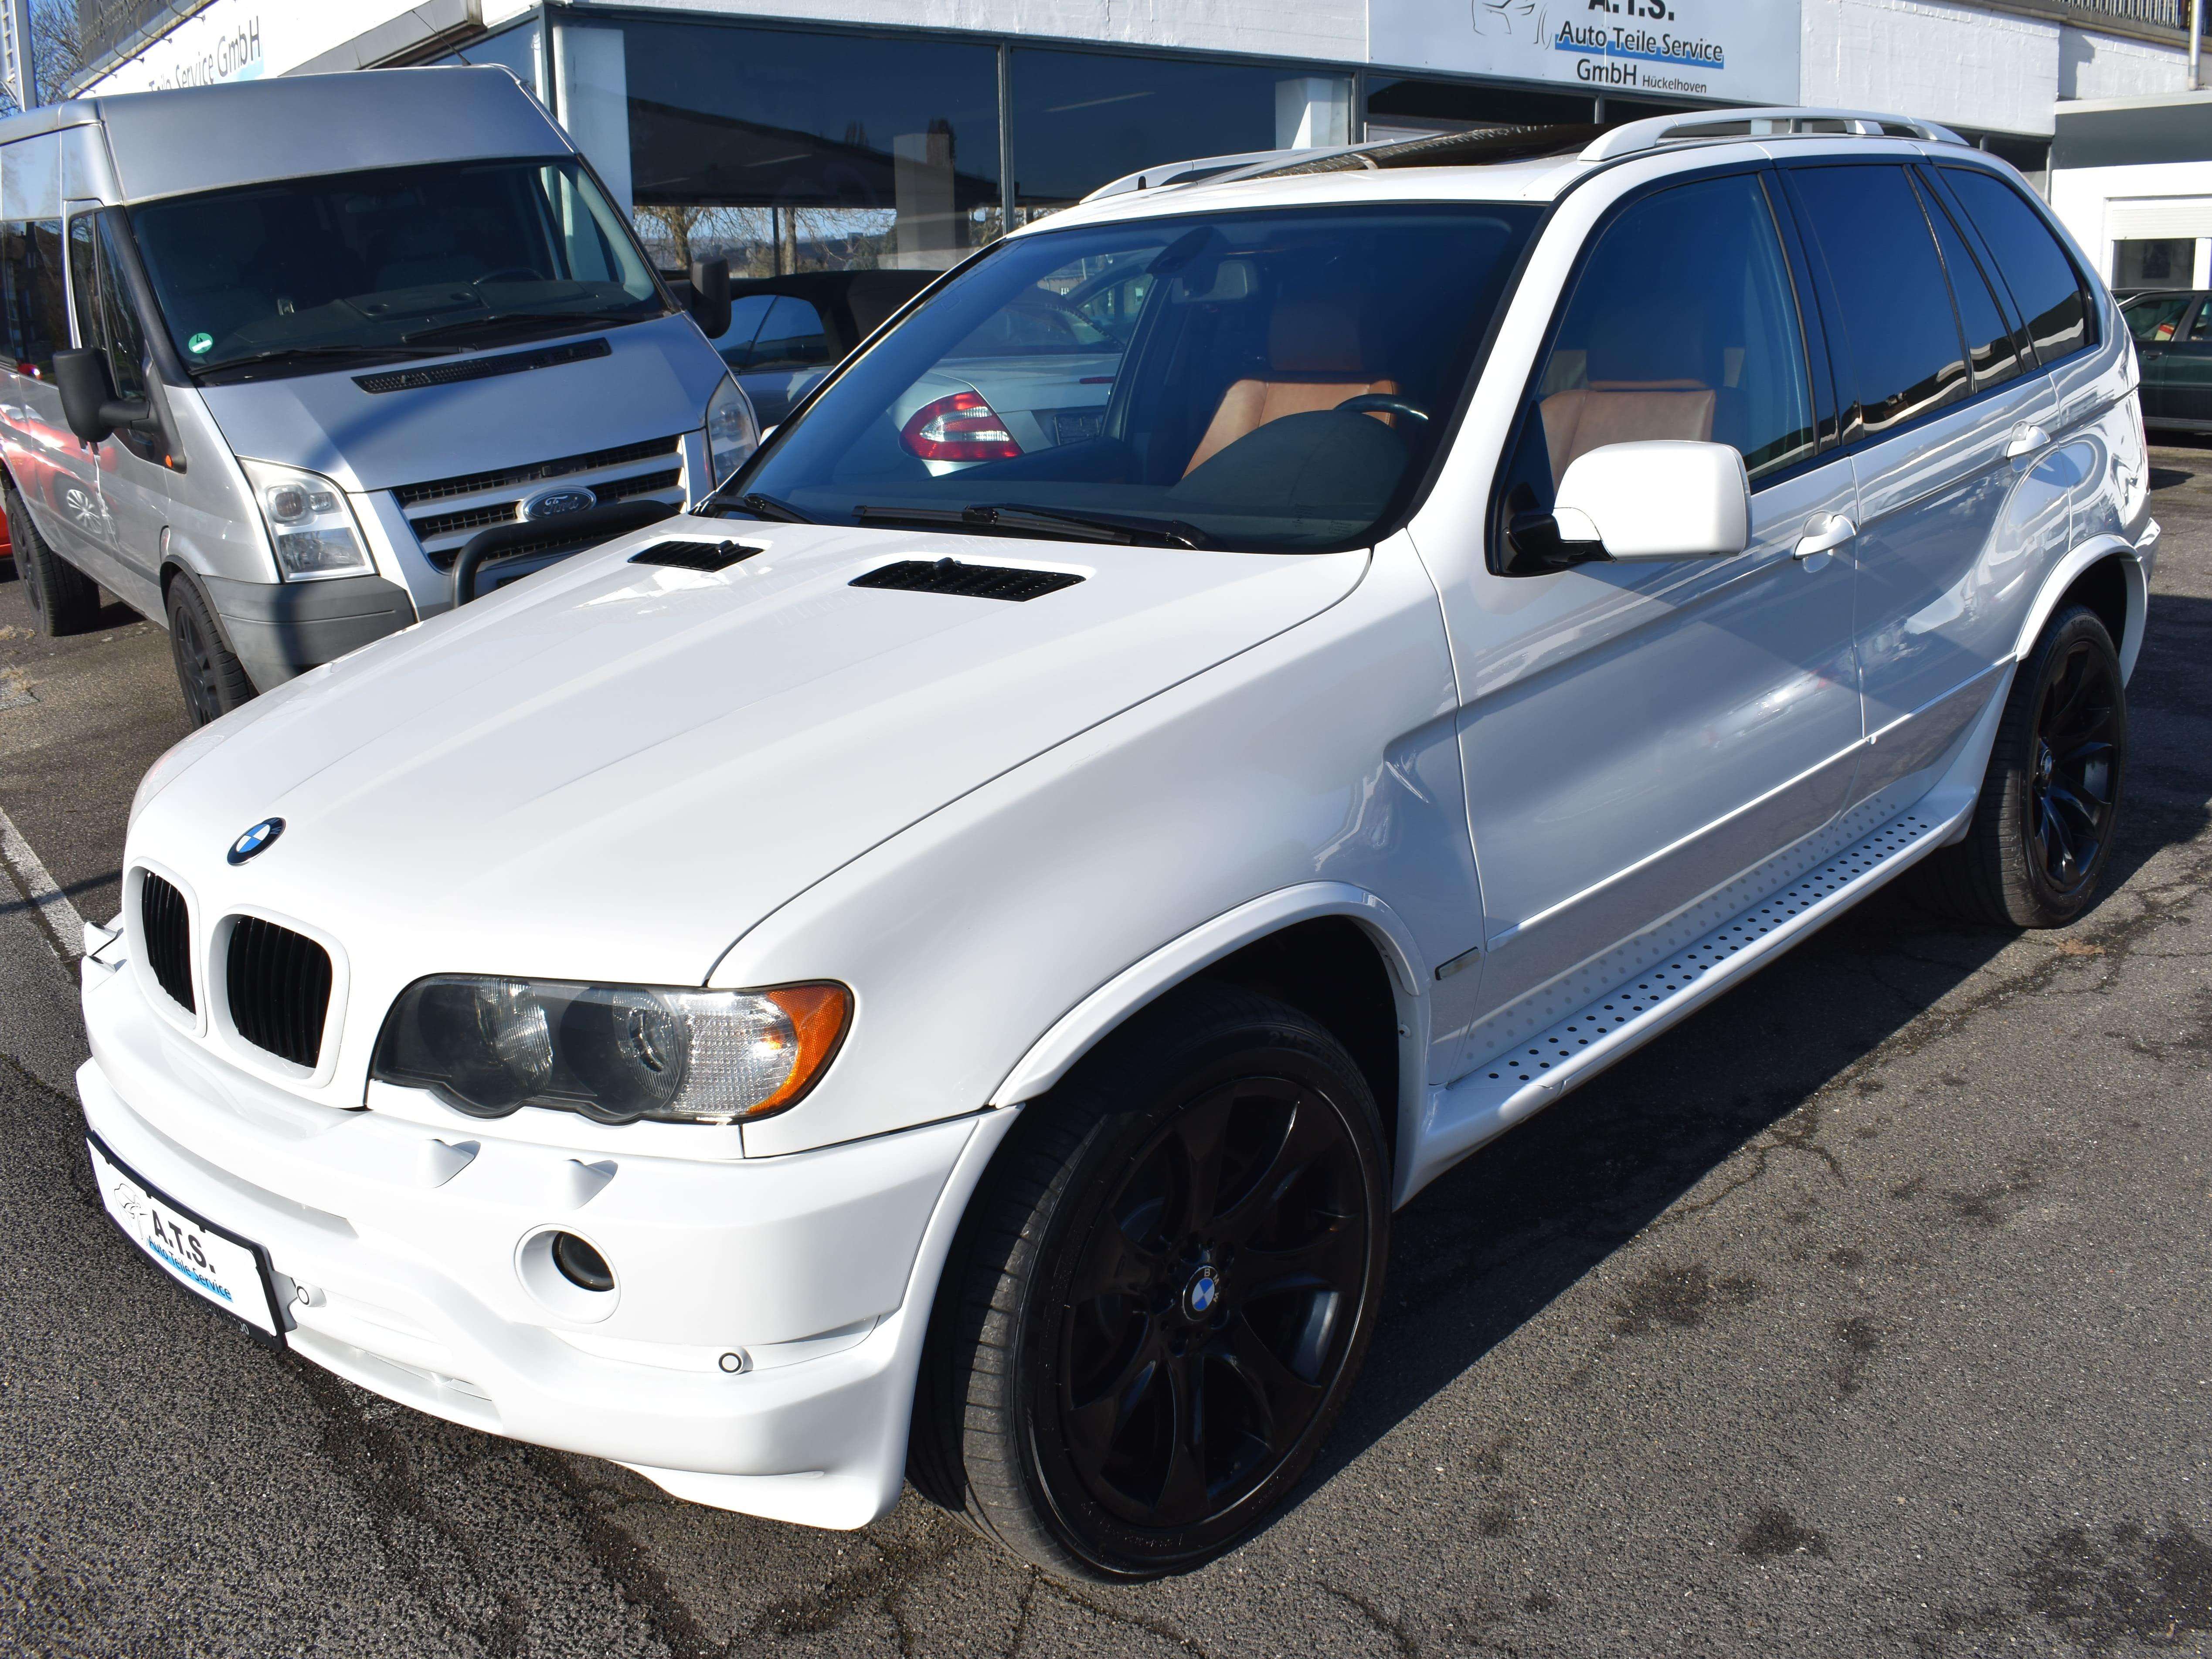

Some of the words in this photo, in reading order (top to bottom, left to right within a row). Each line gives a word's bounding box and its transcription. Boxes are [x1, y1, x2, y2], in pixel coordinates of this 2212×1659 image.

[217, 15, 260, 77] GmbH
[1558, 20, 1607, 47] Auto
[1613, 27, 1656, 53] Teile
[1662, 34, 1723, 61] Service
[1577, 58, 1637, 85] GmbH
[1642, 75, 1707, 93] Hückelhoven
[196, 334, 203, 343] 4
[544, 495, 579, 515] Ford
[152, 1209, 216, 1274] A.T.S.
[149, 1235, 169, 1260] Auto
[168, 1251, 192, 1277] Teile
[192, 1267, 232, 1300] Service
